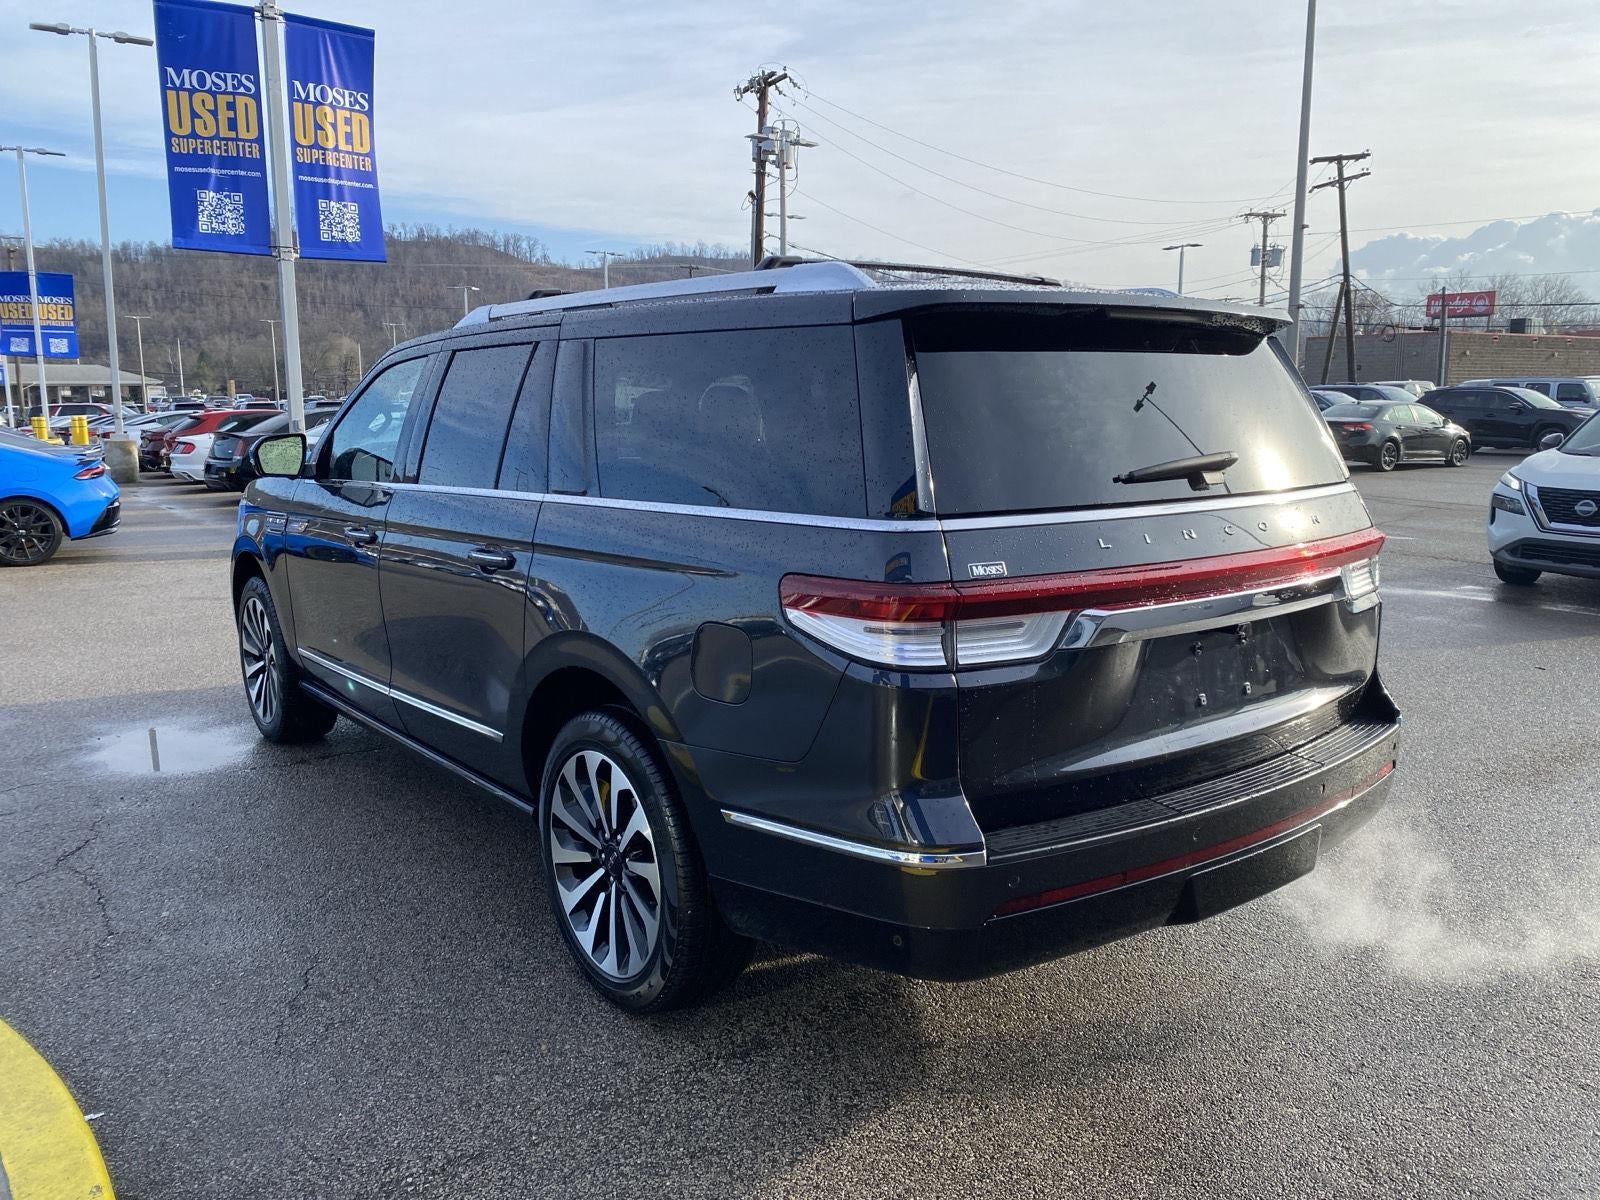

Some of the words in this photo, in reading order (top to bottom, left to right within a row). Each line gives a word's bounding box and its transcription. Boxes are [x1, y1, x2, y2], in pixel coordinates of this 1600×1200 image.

[165, 67, 255, 94] MOSES
[292, 80, 369, 111] MOSES
[167, 90, 258, 139] USED
[293, 102, 370, 154] USED
[171, 137, 260, 159] SUPERCENTER
[296, 147, 372, 172] SUPERCENTER
[174, 166, 261, 177] mosesusedsupercenter.com
[298, 175, 374, 189] mosesusedsupercenter.com
[0, 295, 32, 303] MOSES
[38, 296, 73, 304] MOSES
[1431, 296, 1471, 313] Wndy's
[0, 303, 33, 319] USED
[39, 303, 73, 320] USED
[1098, 514, 1321, 549] LINCON
